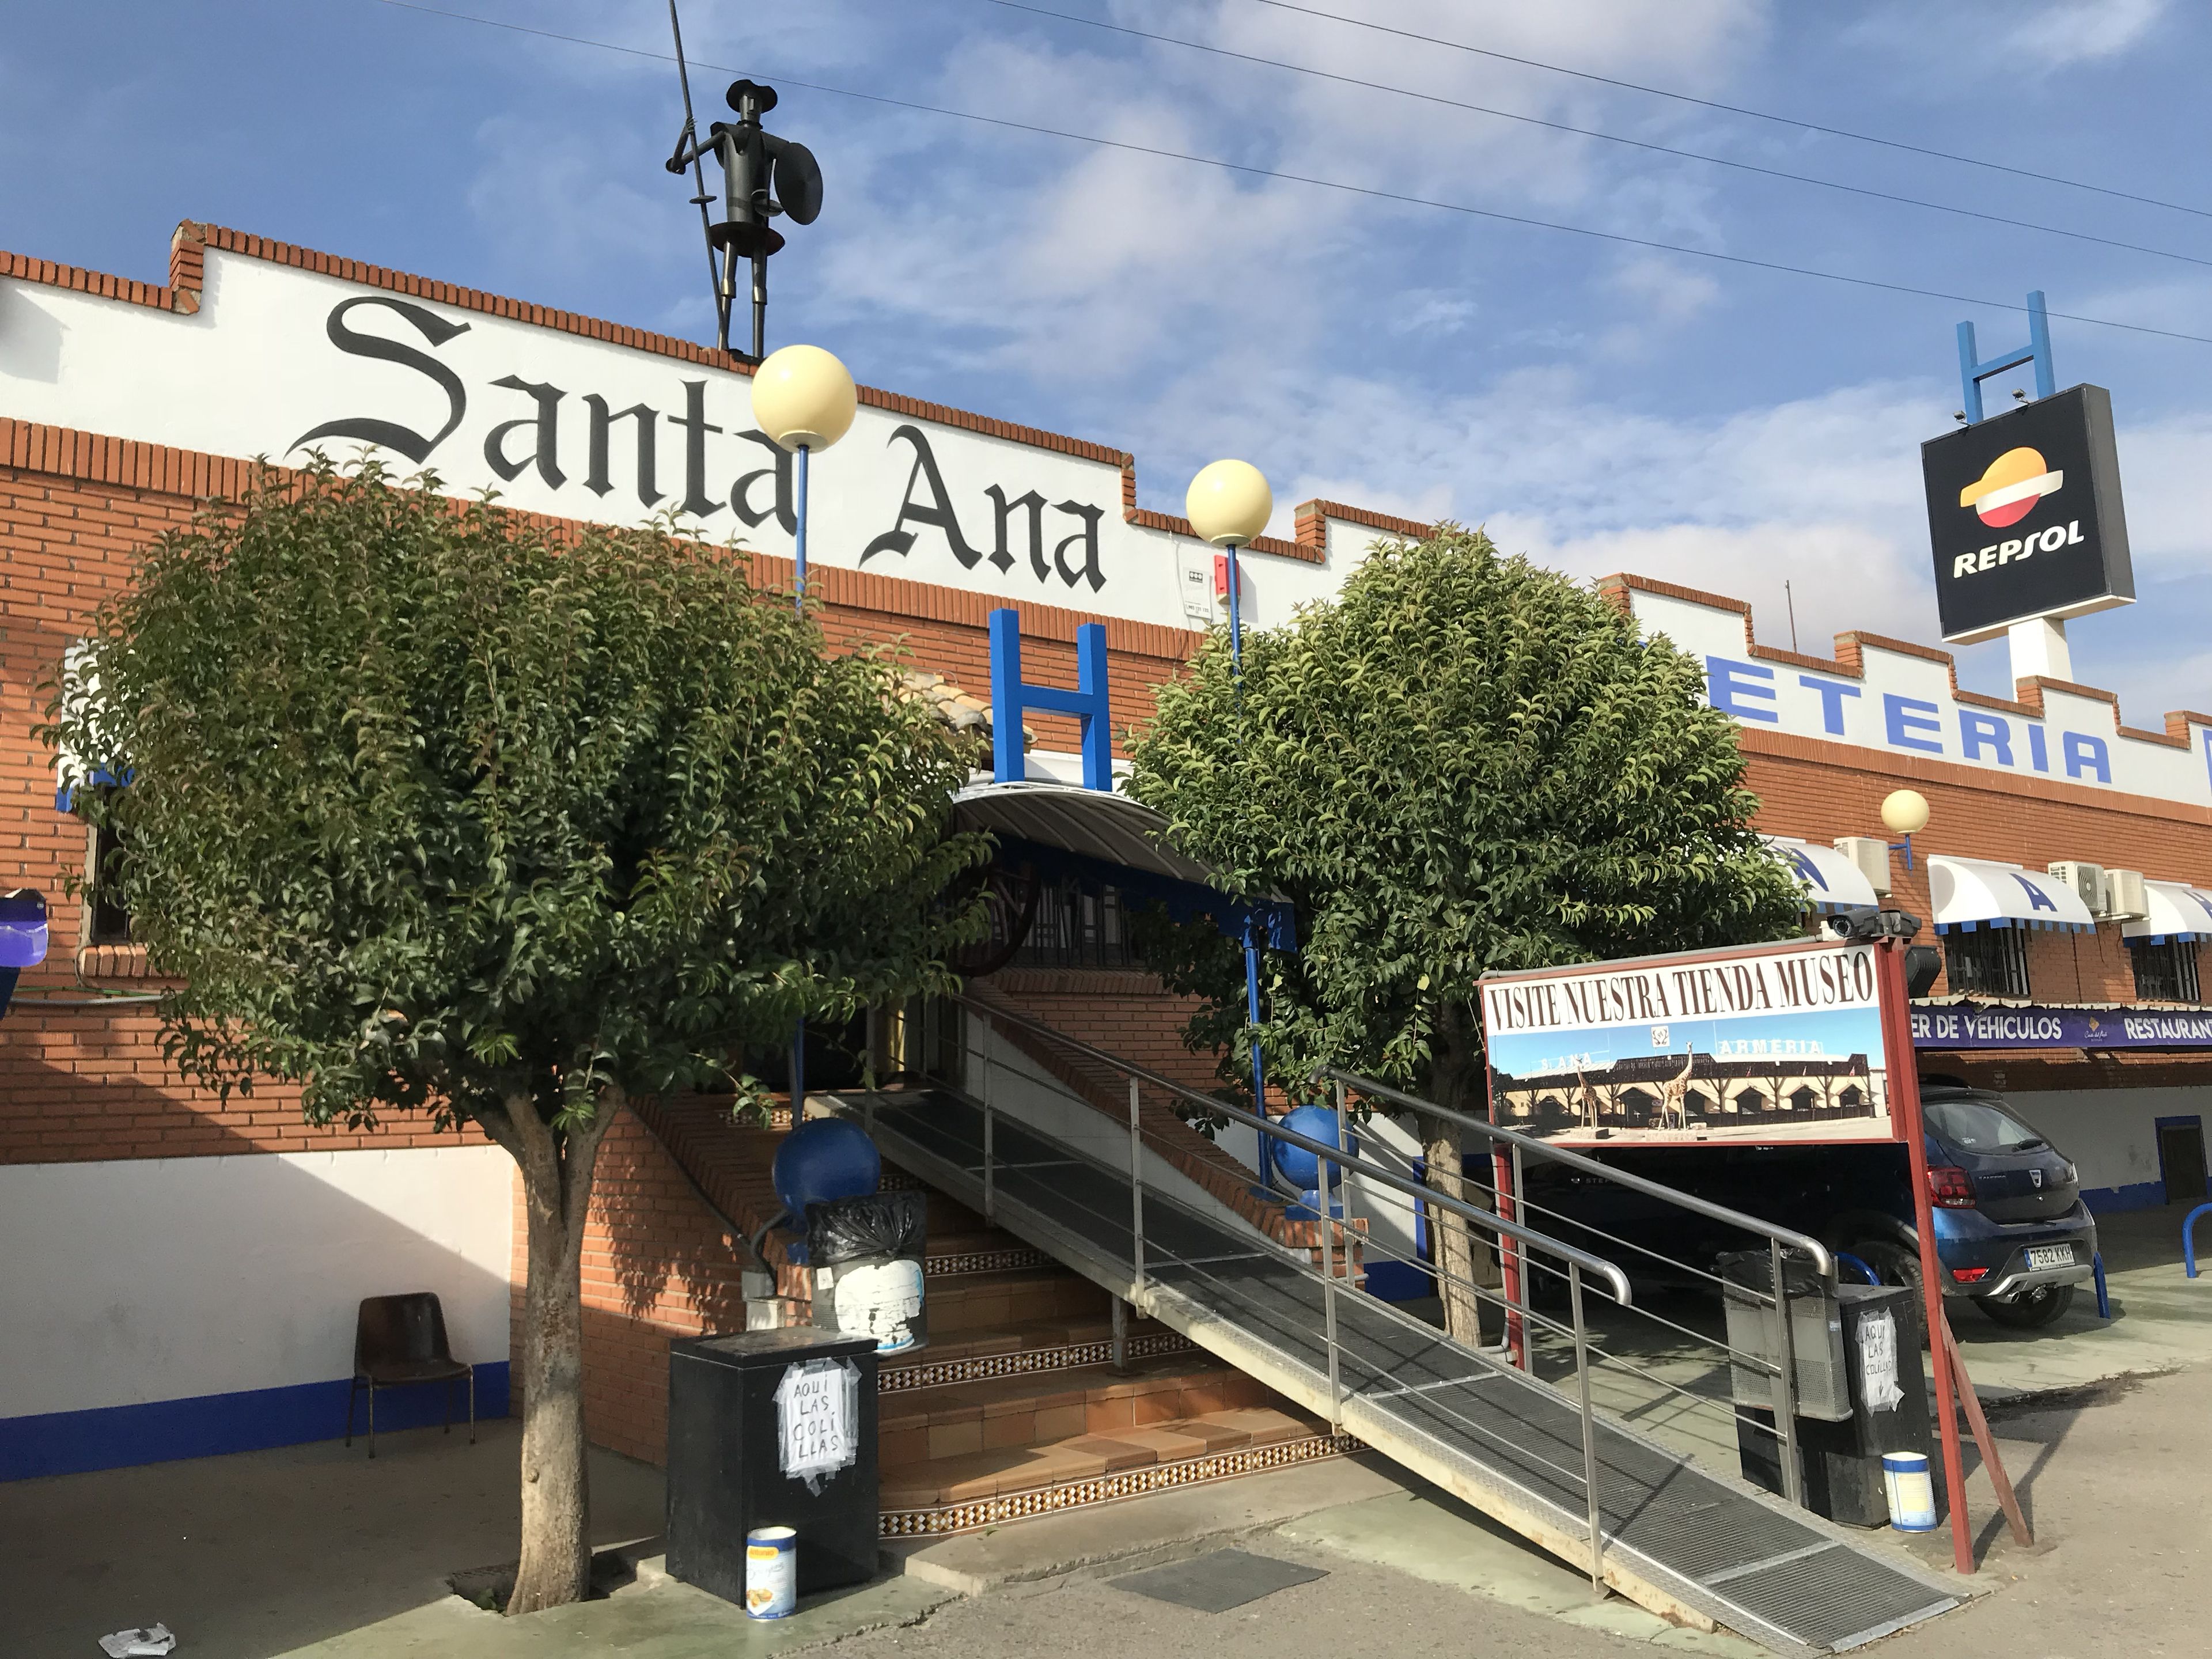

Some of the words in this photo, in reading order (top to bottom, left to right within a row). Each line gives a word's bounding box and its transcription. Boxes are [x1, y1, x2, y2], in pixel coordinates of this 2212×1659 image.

[283, 296, 798, 537] Santa
[858, 425, 1107, 594] Ana
[1953, 520, 2084, 578] REPSOL
[1706, 655, 2112, 783] ETERIA
[1489, 984, 1560, 1031] VISITE
[1563, 974, 1672, 1024] NUESTRA
[1672, 963, 1772, 1016] TIENDA
[1774, 952, 1873, 1007] MUSEO
[1911, 1014, 1931, 1039] ER
[1937, 1014, 1959, 1039] DE
[1964, 1016, 2062, 1040] VEHICULOS
[1721, 1039, 1823, 1054] ARMERIA
[2031, 1247, 2055, 1266] 7582
[2055, 1244, 2073, 1262] KKH
[1868, 1342, 1883, 1358] LAS
[800, 1395, 829, 1415] LAS
[799, 1435, 838, 1458] LLAS
